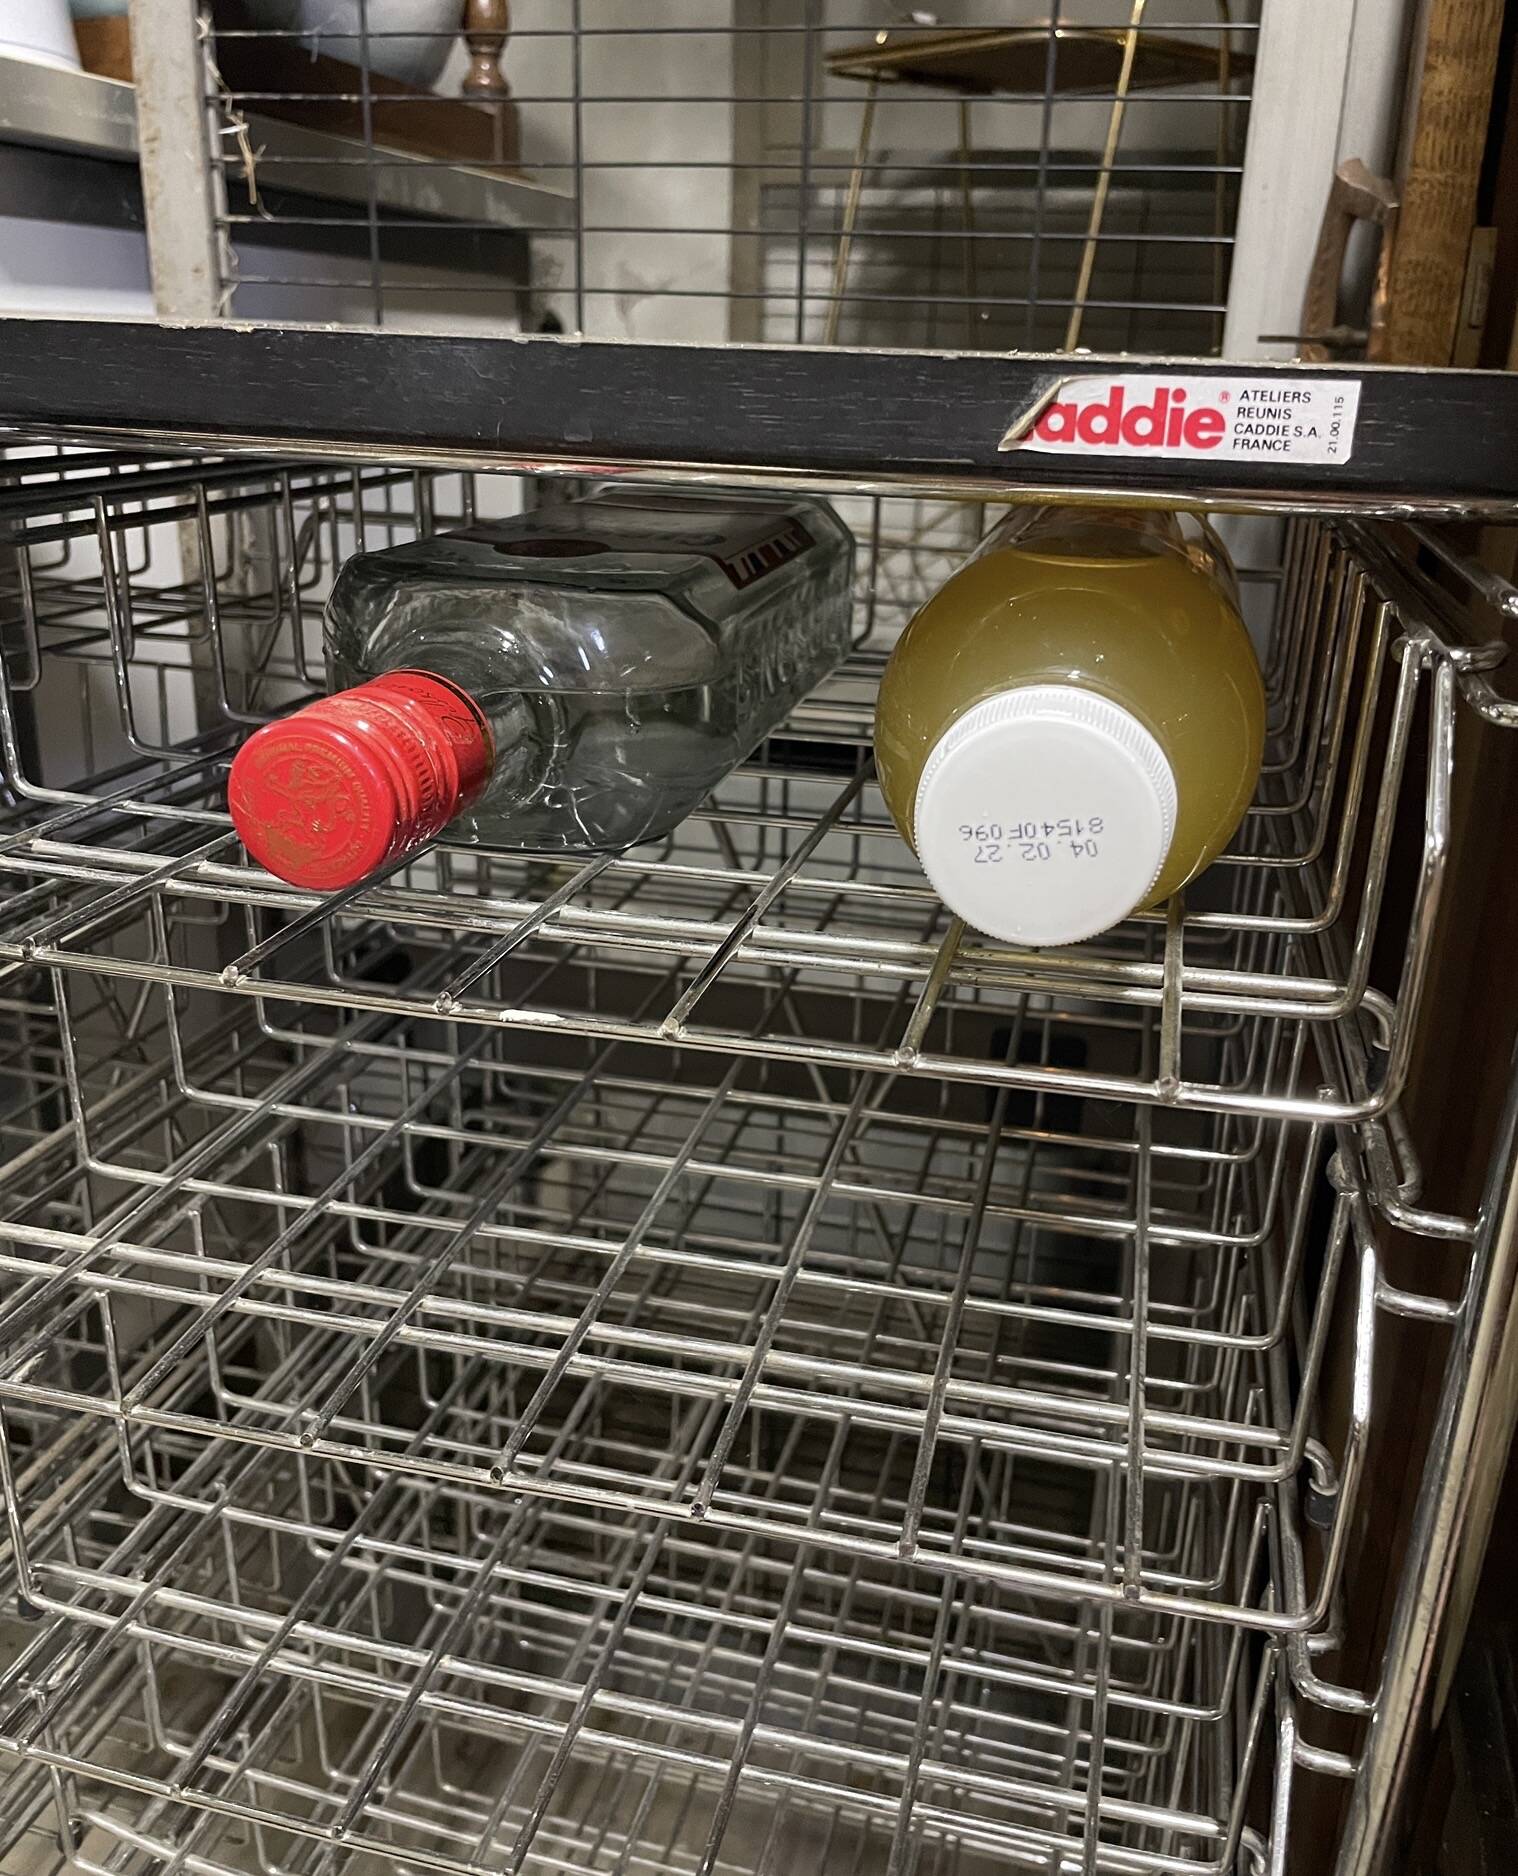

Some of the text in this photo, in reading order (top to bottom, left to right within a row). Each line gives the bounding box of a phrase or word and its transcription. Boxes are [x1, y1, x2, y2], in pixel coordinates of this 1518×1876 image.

[1239, 390, 1312, 404] ATELIERS
[1019, 386, 1226, 449] addie
[1236, 407, 1292, 420] REUNIS
[1234, 423, 1322, 439] CADDIE S.A.
[1327, 396, 1345, 454] 21.00.115
[1232, 438, 1291, 452] FRANCE
